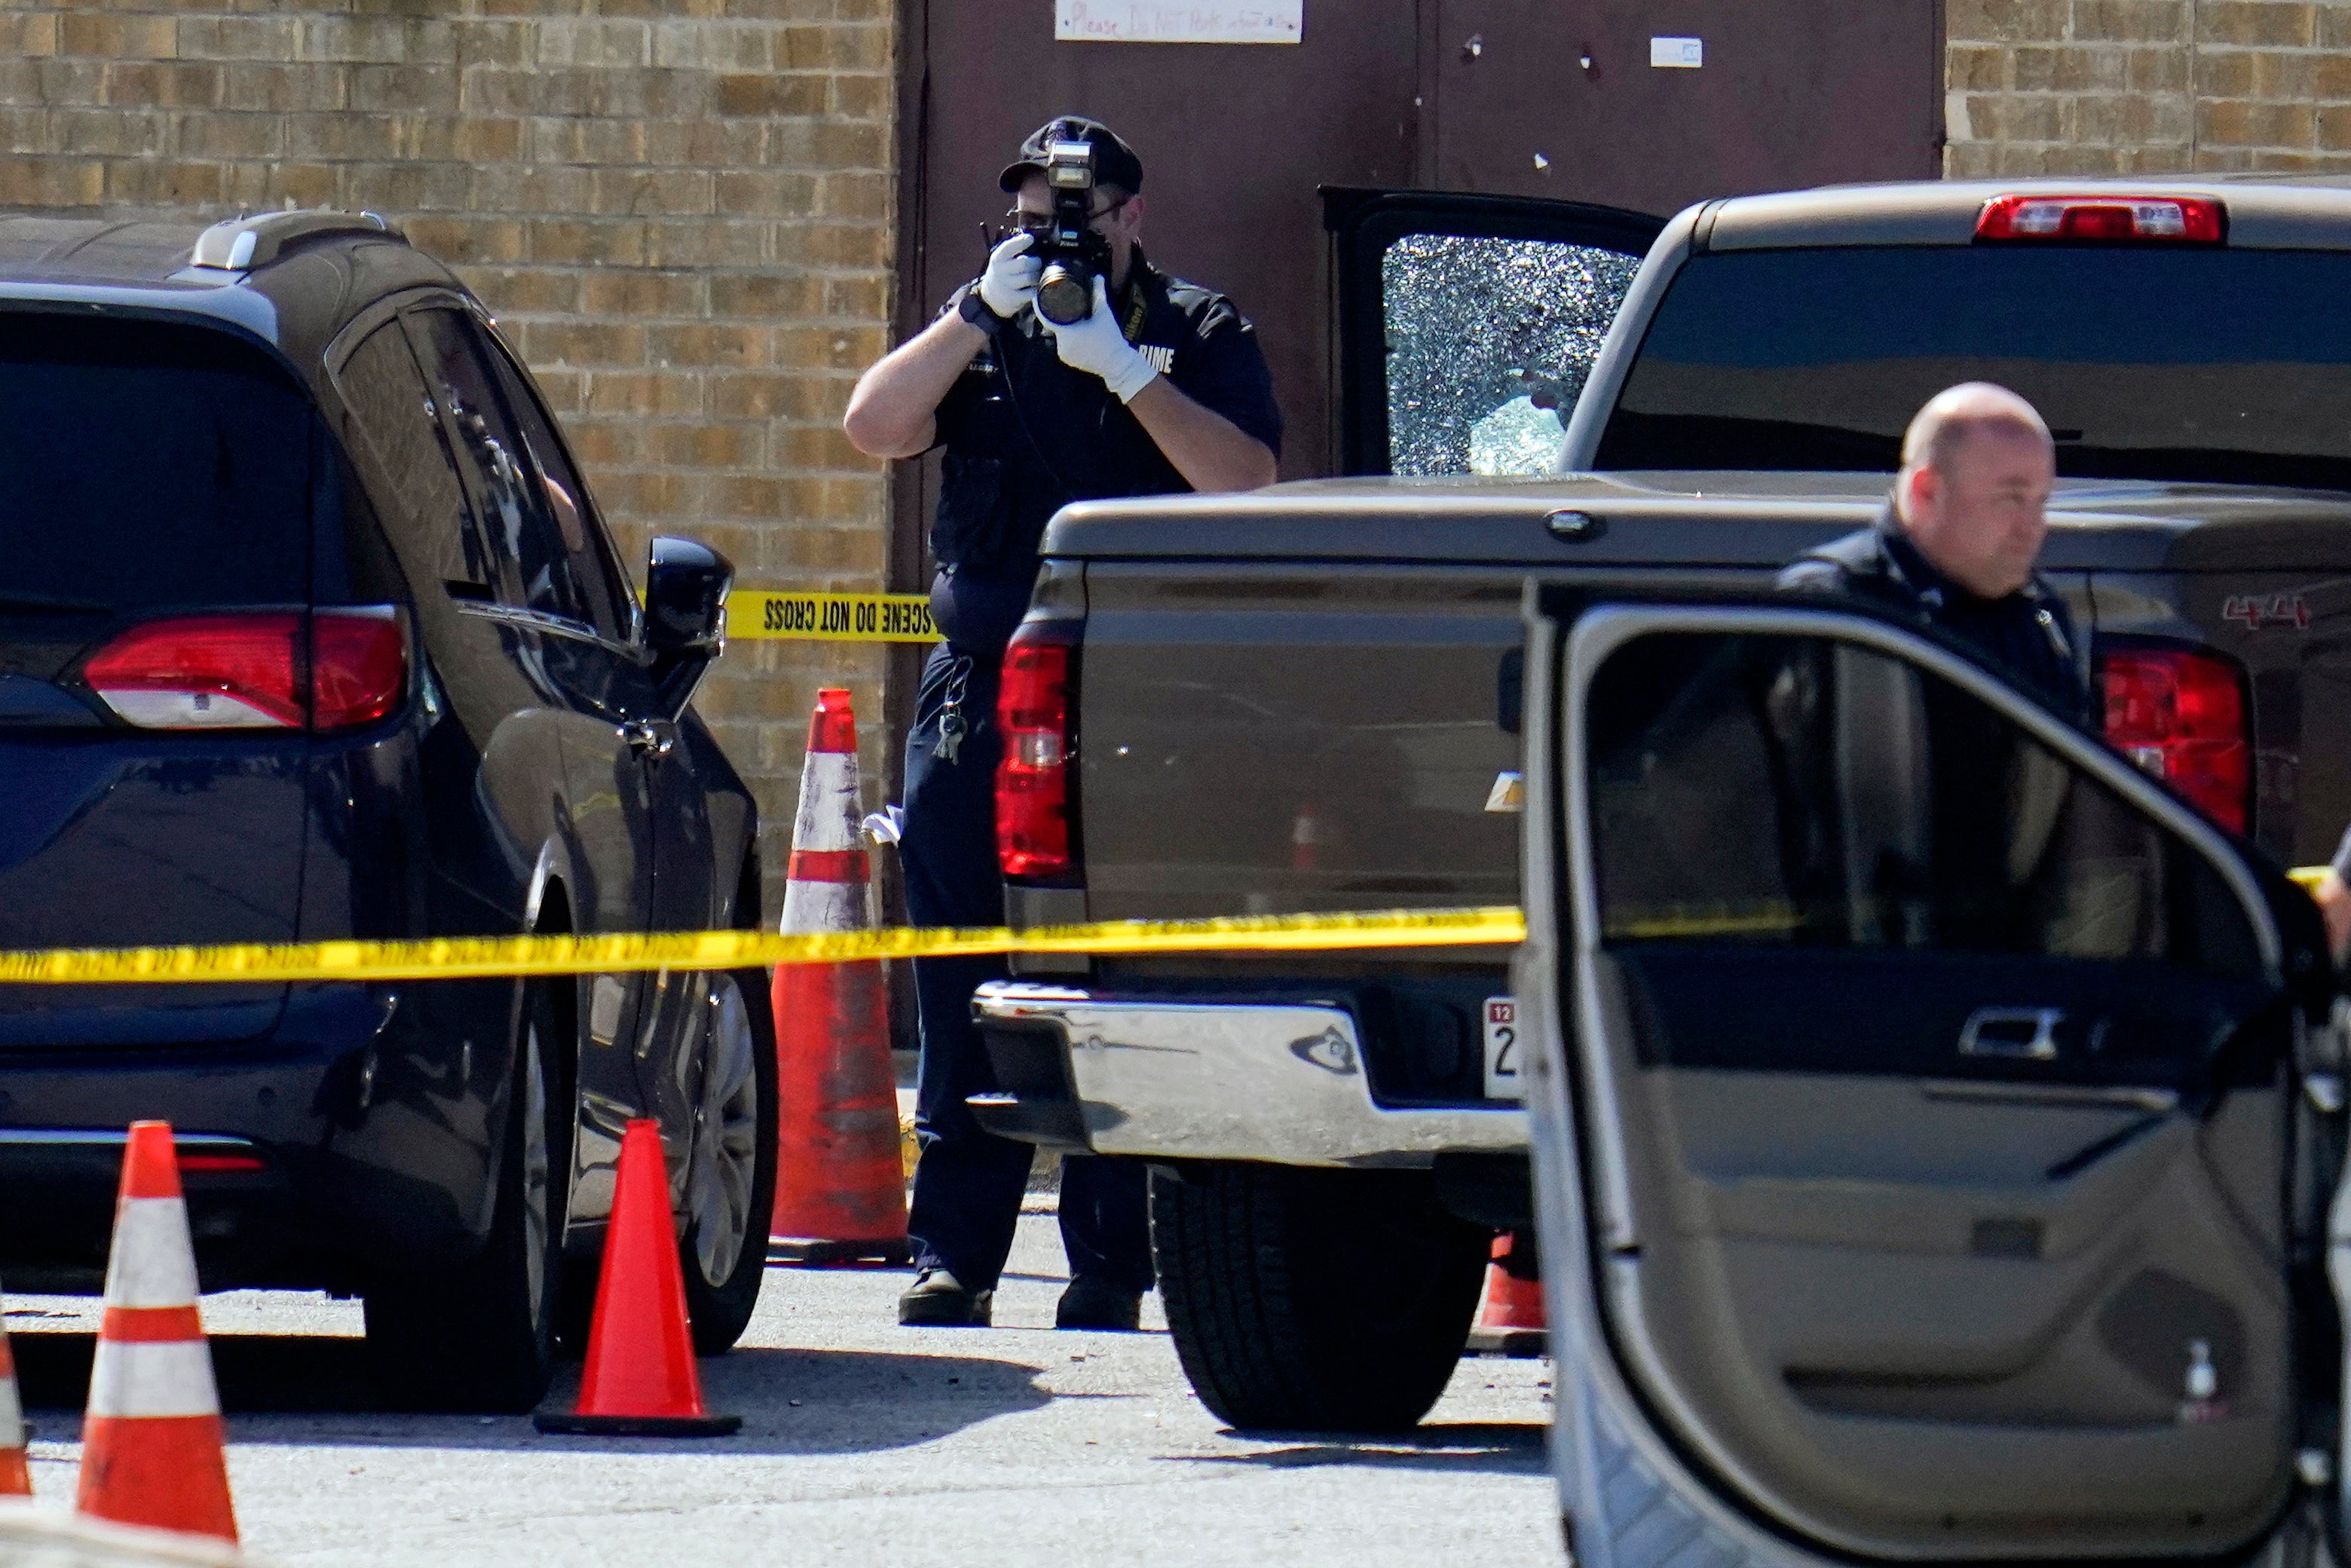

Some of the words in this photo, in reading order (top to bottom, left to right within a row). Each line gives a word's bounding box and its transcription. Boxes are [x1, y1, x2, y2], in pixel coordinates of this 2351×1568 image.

[1072, 1, 1119, 36] Please
[1139, 344, 1175, 374] RIME
[764, 599, 816, 632] CROSS
[820, 601, 849, 633] NOT
[856, 602, 877, 633] DO
[882, 602, 932, 635] SCENE
[1494, 1005, 1512, 1020] 12
